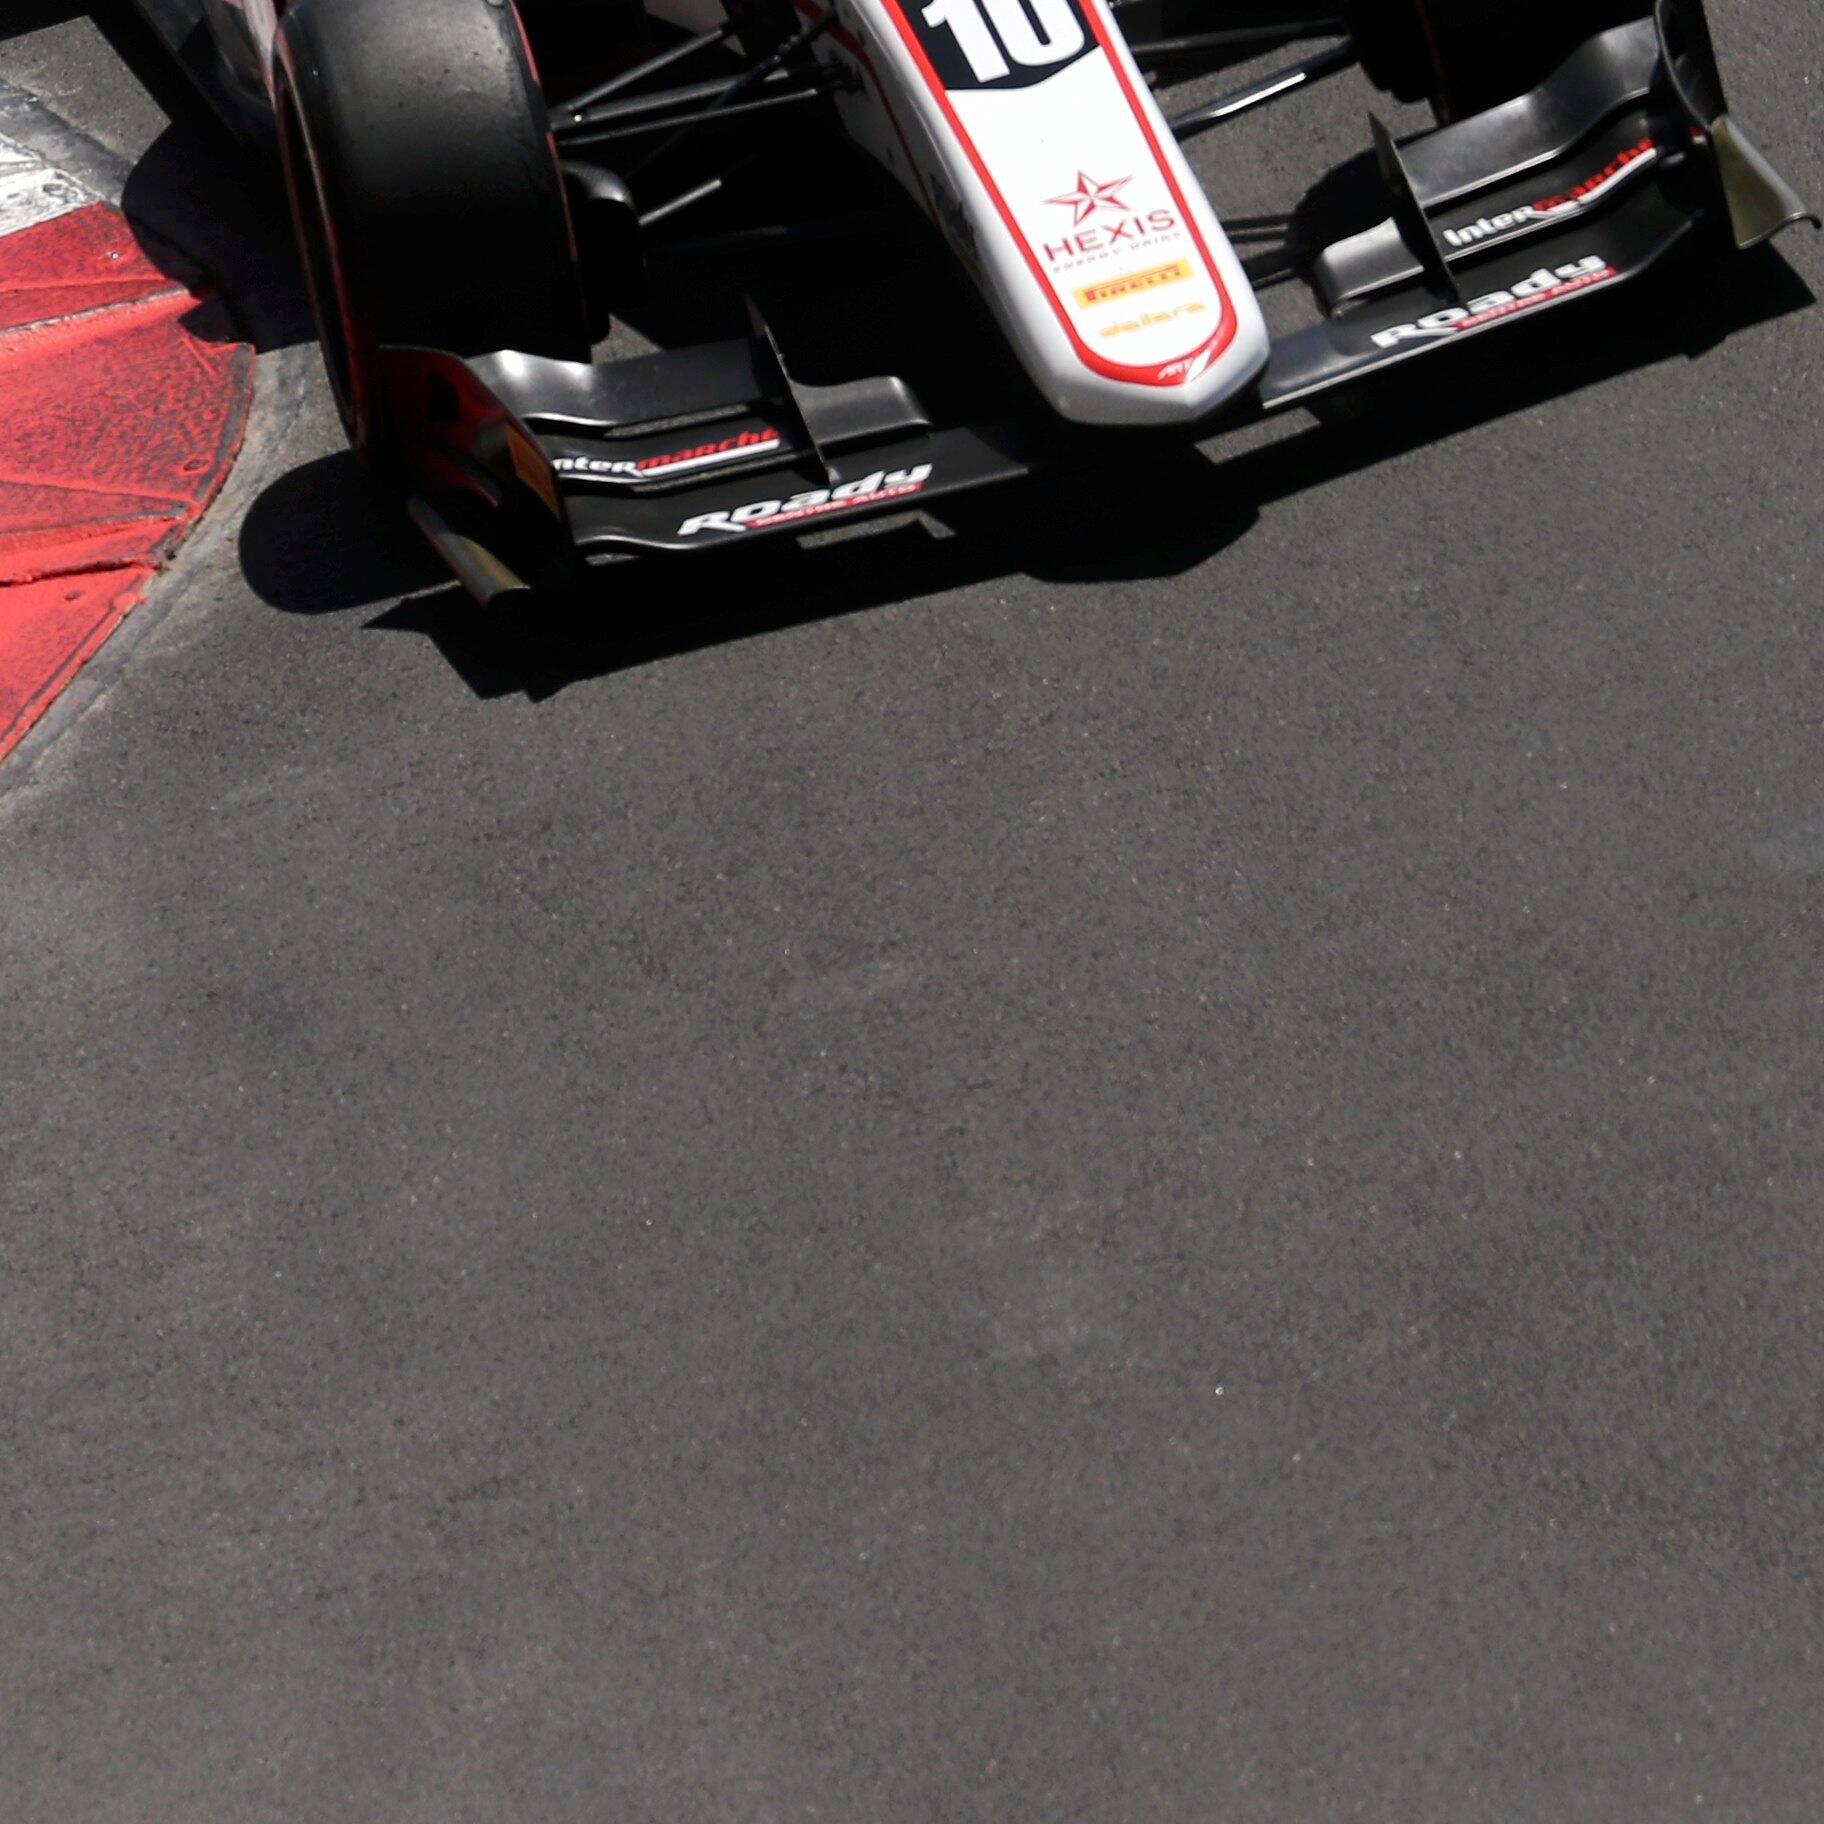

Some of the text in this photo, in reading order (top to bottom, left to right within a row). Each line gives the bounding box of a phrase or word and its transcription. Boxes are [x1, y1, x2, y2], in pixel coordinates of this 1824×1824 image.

[1042, 208, 1176, 262] HEXIS
[1371, 254, 1607, 348] Roady
[677, 463, 933, 536] Roady
